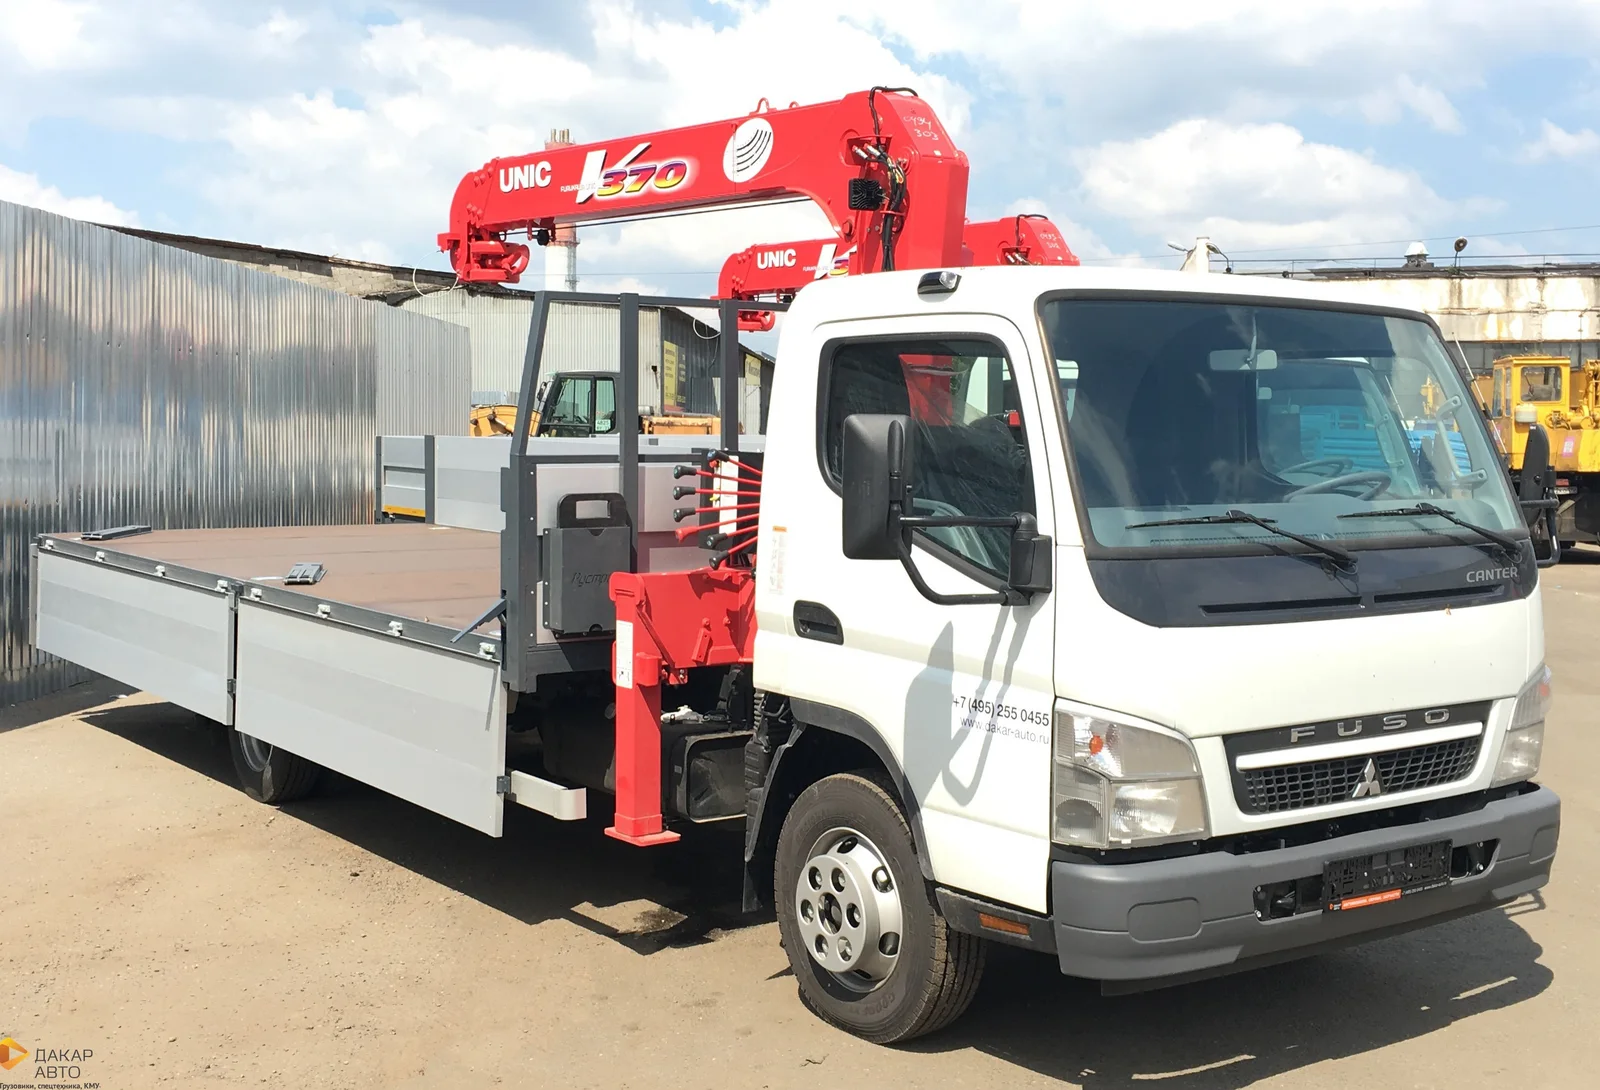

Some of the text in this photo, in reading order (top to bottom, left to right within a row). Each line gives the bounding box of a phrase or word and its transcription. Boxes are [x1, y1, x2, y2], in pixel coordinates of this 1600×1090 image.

[499, 160, 552, 193] UNIC
[756, 248, 797, 270] UNIC
[1466, 566, 1519, 583] CANTER
[952, 695, 1050, 727] +7 (495) 255 0455
[1290, 708, 1450, 743] FUSO
[960, 716, 1050, 745] www.dakar-auto.ru
